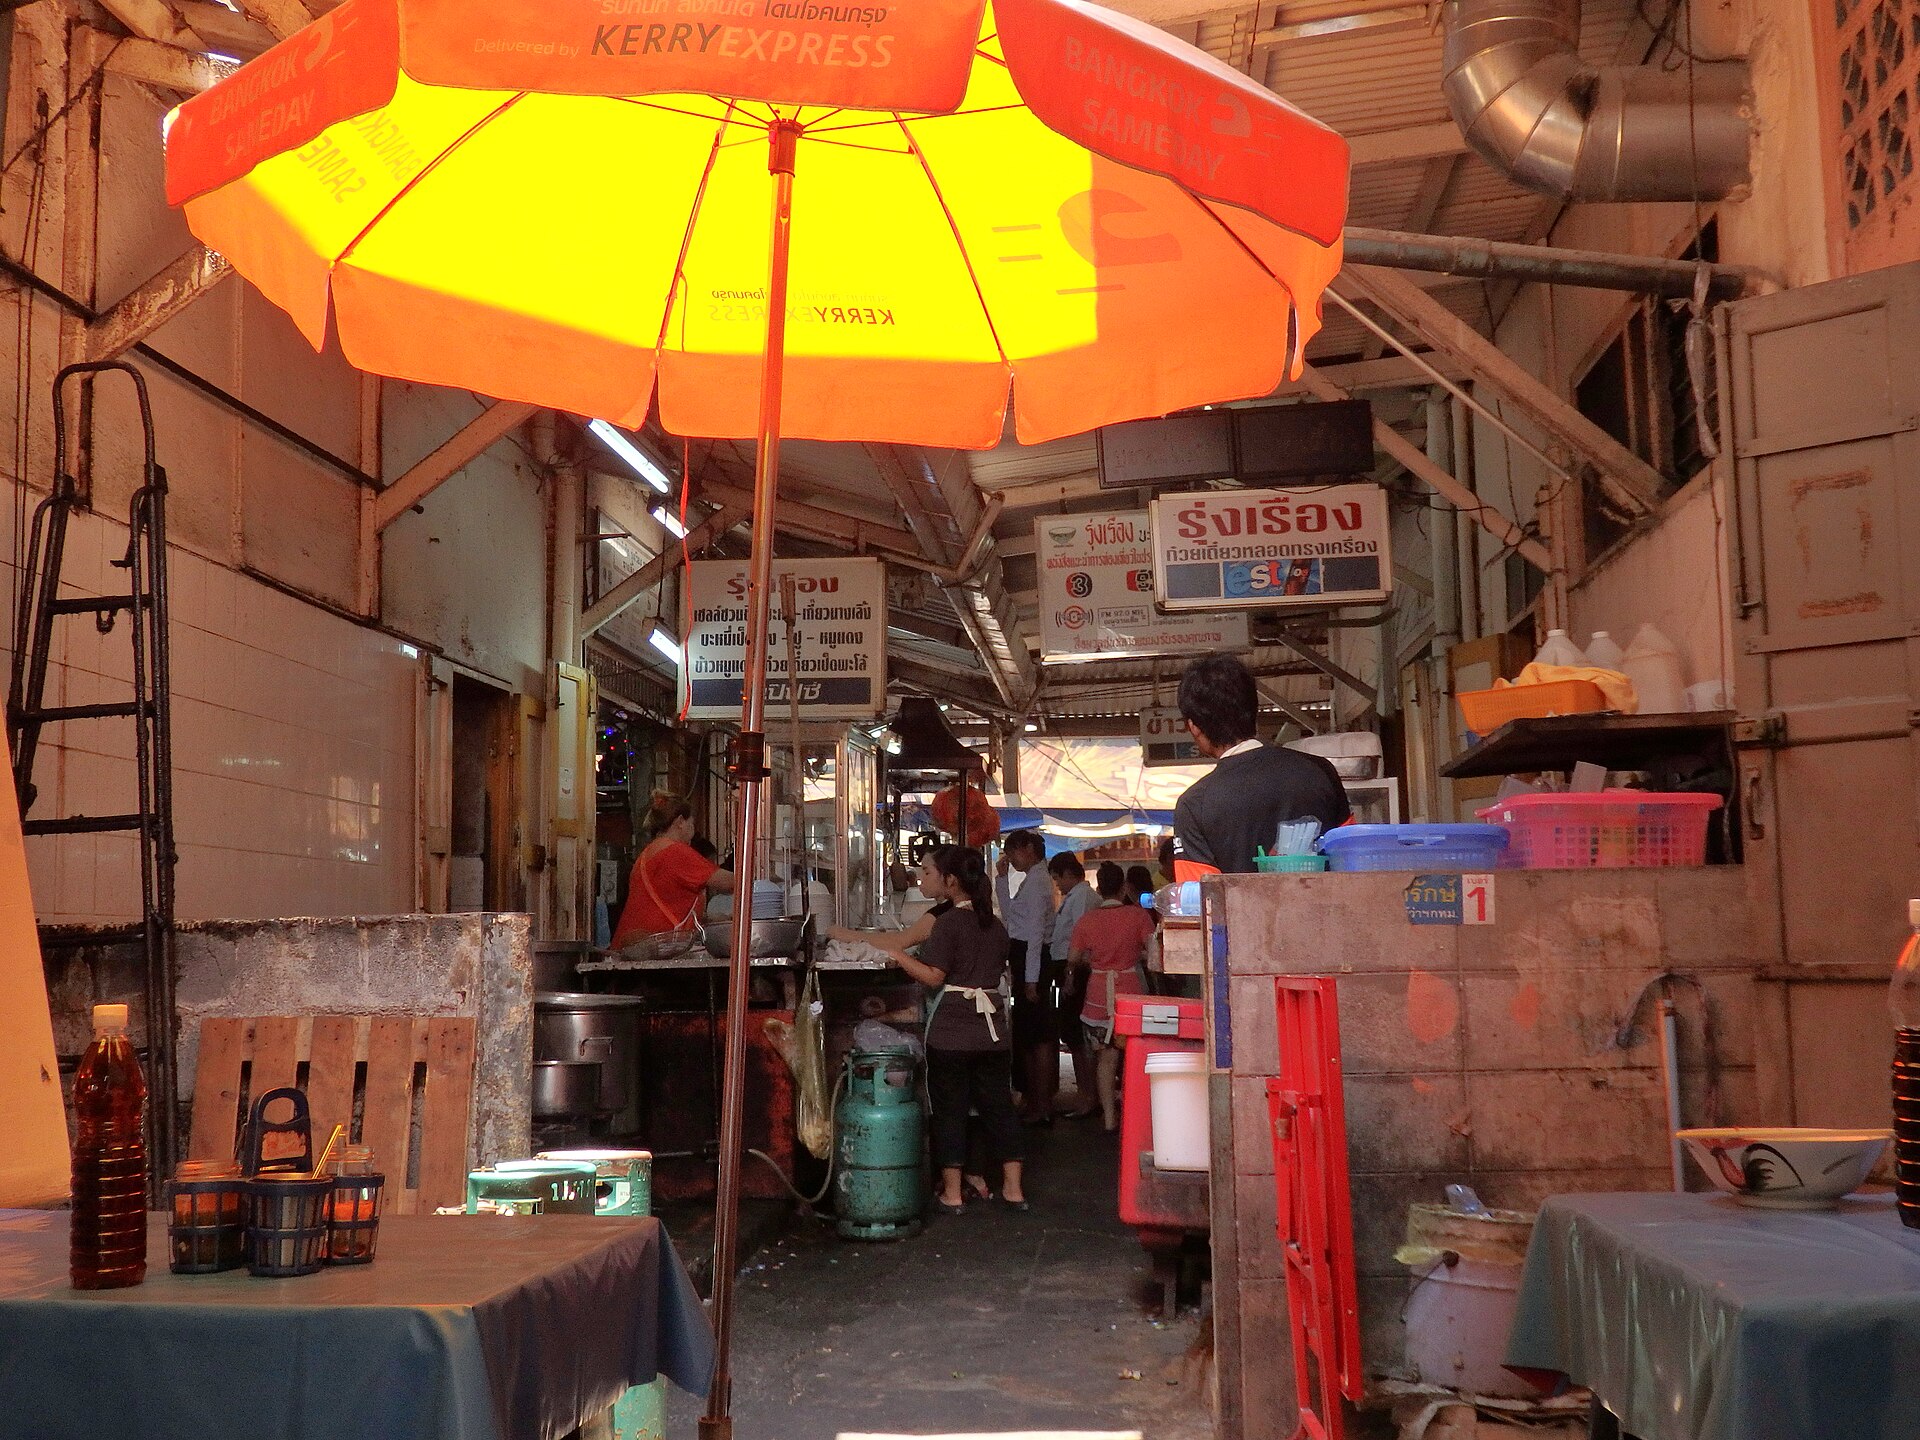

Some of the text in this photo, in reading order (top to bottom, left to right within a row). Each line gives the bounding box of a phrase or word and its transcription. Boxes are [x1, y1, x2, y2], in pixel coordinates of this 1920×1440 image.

[474, 37, 554, 56] Delivered
[559, 42, 580, 59] by
[209, 47, 301, 126] BANGKOK
[1064, 35, 1204, 124] BANGKOK
[1085, 516, 1134, 551] รุ่งเรือง
[1177, 496, 1363, 546] รุ่งเรือง
[1227, 561, 1281, 595] est
[820, 632, 864, 650] หมูแดง
[1467, 886, 1486, 922] 1
